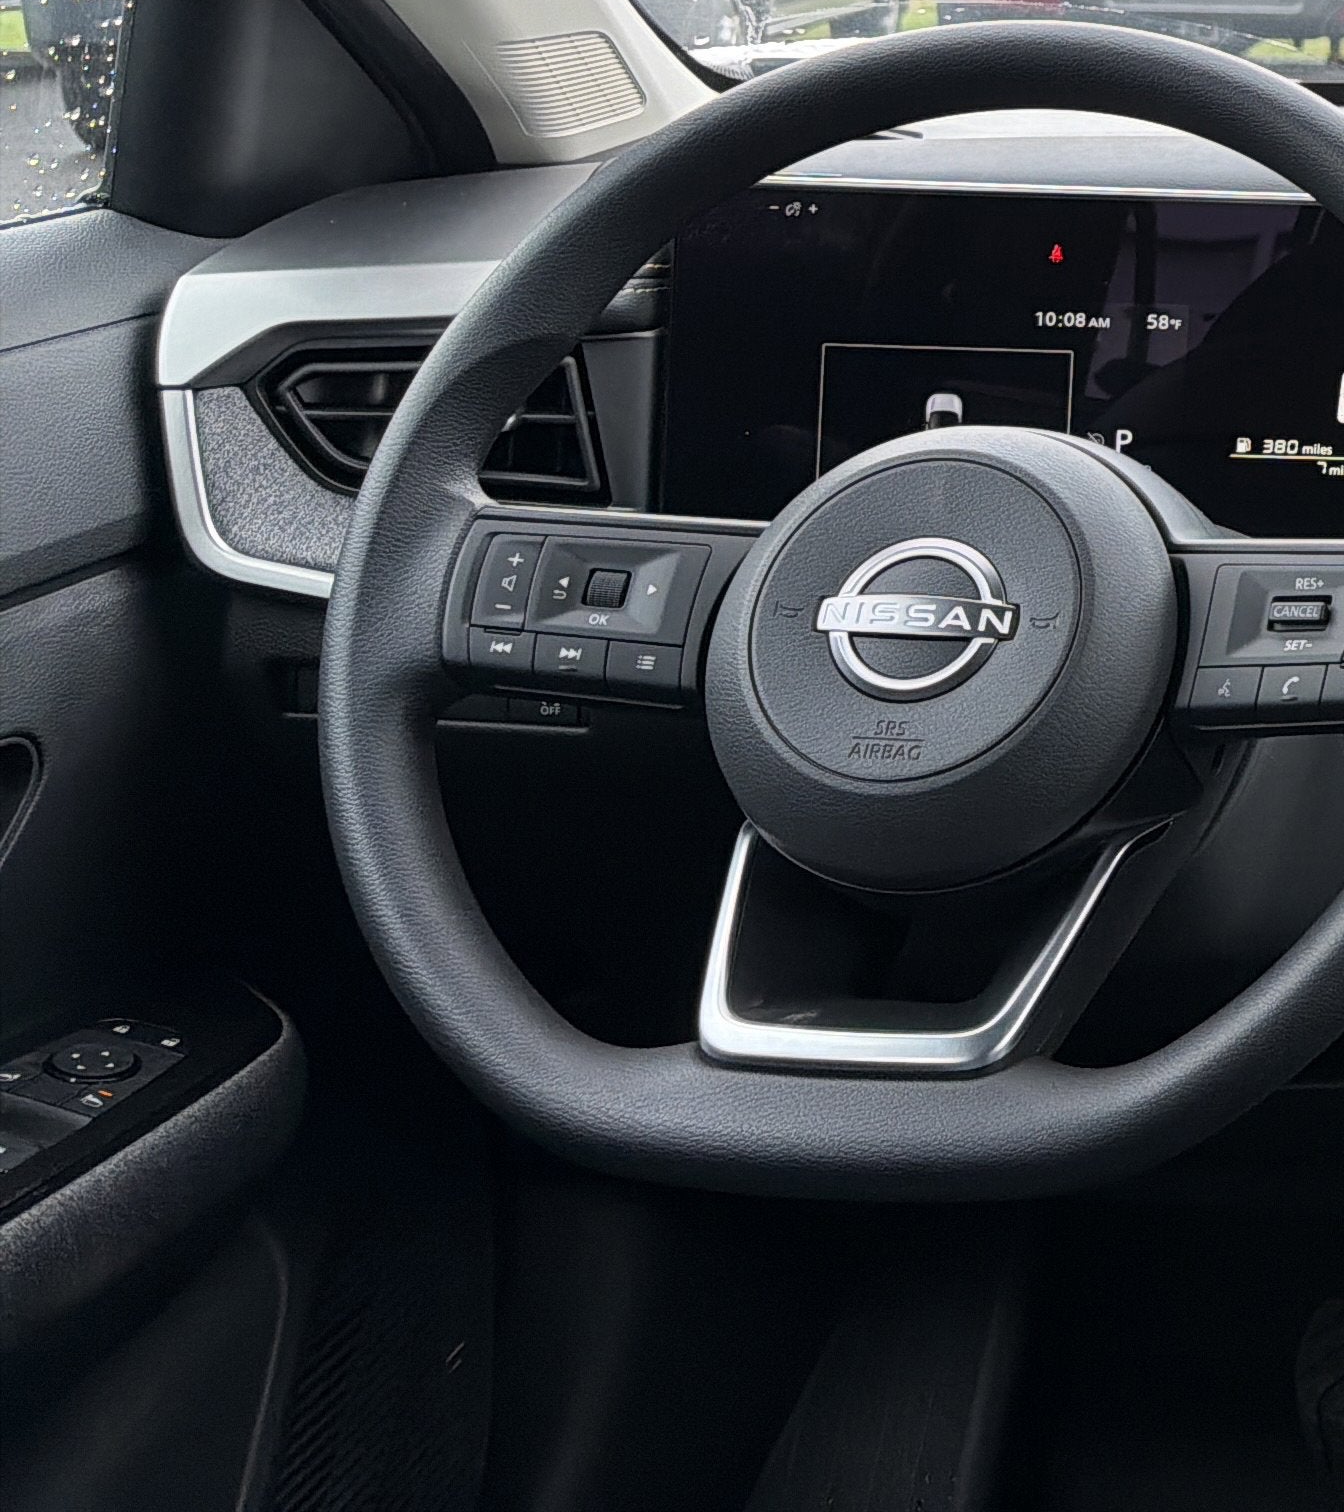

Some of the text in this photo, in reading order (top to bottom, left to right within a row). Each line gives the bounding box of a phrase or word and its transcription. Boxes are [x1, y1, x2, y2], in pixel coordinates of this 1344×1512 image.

[1034, 311, 1111, 329] 10:08 AM
[1115, 429, 1133, 453] P
[1262, 439, 1333, 456] 380 miles
[1295, 577, 1325, 590] RES+
[588, 613, 610, 626] OK
[822, 600, 1013, 635] NISSAN
[1273, 605, 1320, 618] CANCEL
[540, 705, 561, 716] OFF
[873, 719, 910, 737] SRS
[849, 741, 923, 761] AIRBAG
